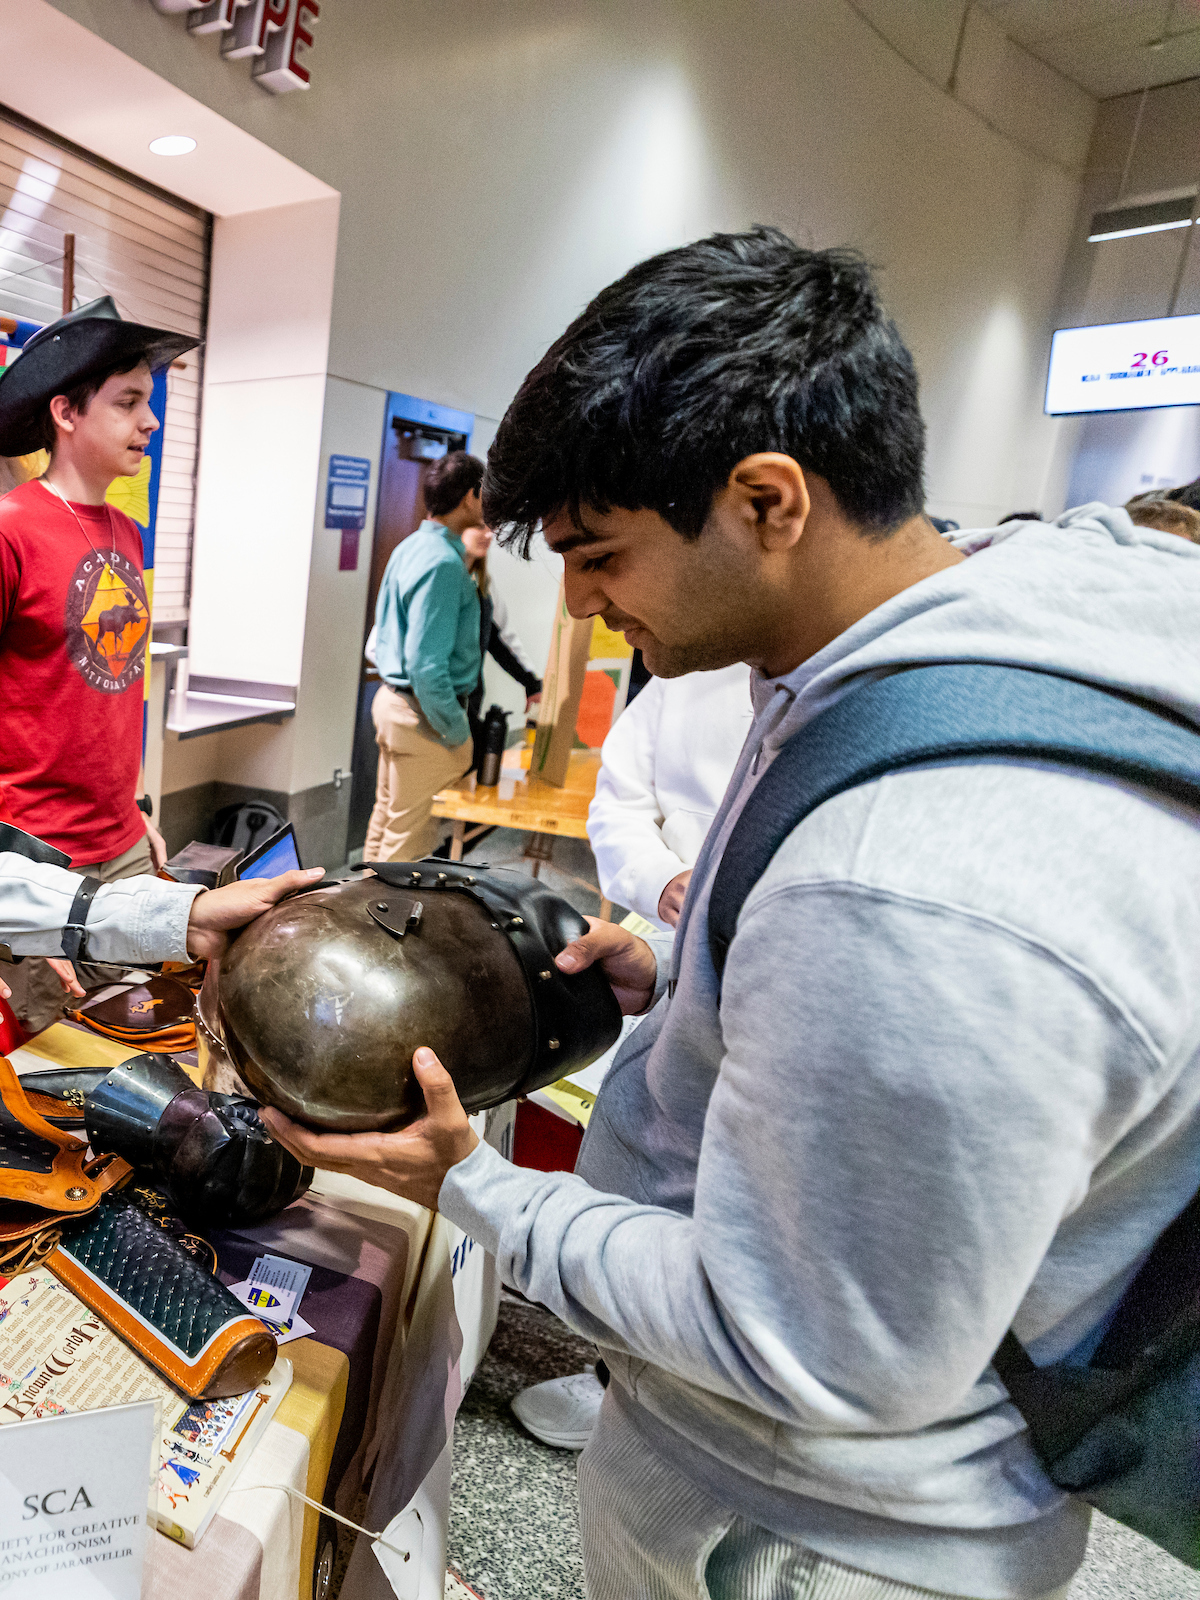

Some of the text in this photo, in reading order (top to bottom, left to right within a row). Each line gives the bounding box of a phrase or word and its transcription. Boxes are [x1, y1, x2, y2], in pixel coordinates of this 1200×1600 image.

[1130, 350, 1169, 368] 26
[0, 1370, 53, 1421] Known
[42, 1334, 83, 1375] World
[21, 1486, 94, 1521] SCA
[39, 1529, 66, 1543] FOR
[72, 1515, 140, 1537] CREATIVE
[2, 1535, 112, 1565] ANACHRONISM
[34, 1563, 51, 1575] OF
[53, 1548, 133, 1571] JARARVELLIR
